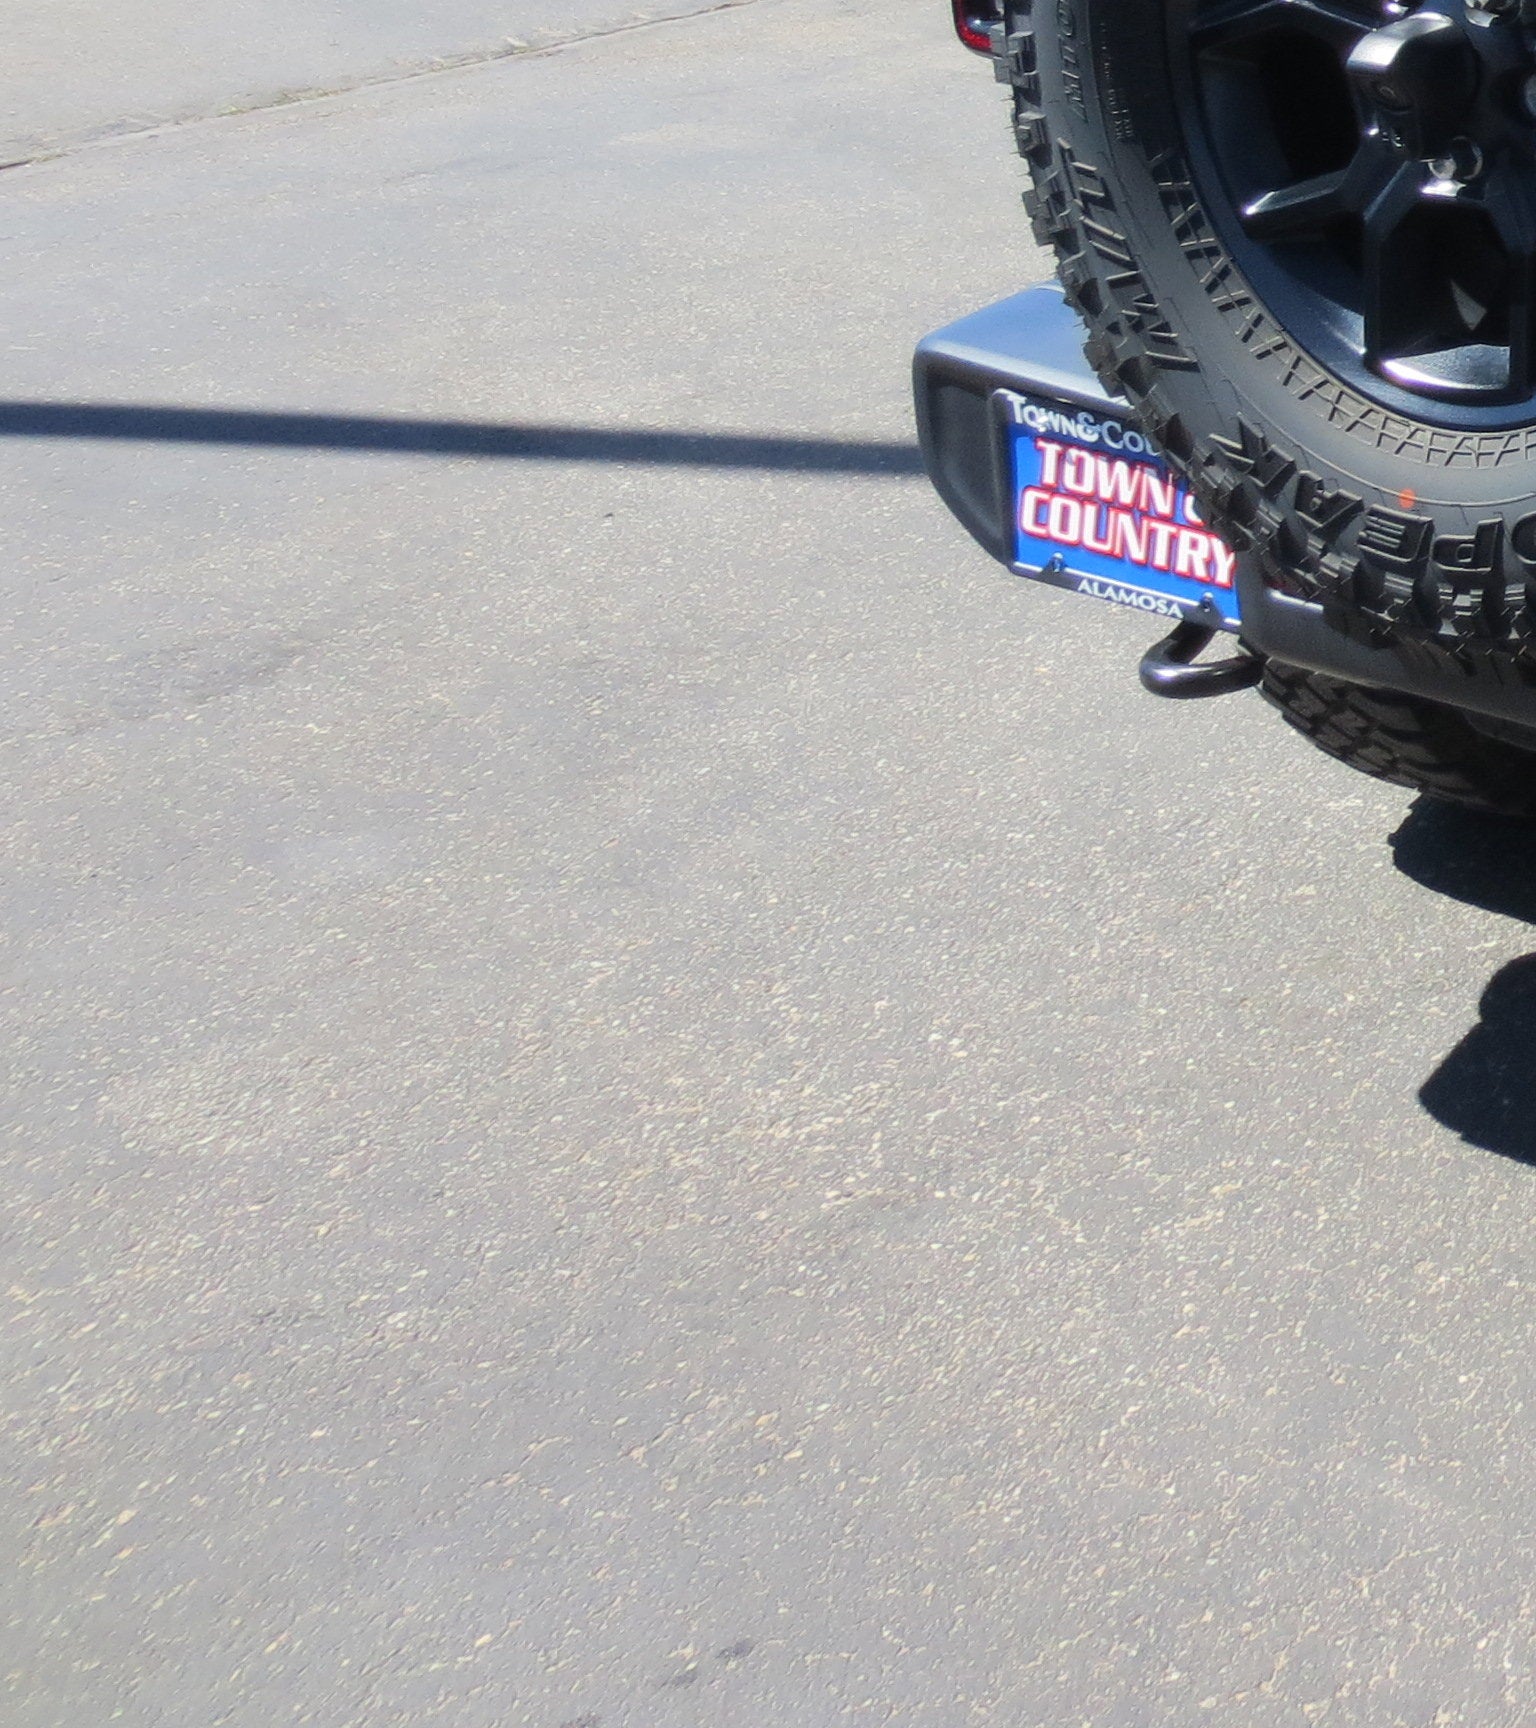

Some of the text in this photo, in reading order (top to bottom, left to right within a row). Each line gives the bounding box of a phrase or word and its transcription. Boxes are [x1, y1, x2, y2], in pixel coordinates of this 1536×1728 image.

[1035, 437, 1177, 519] TOWN
[1020, 485, 1238, 589] COUNTRY
[1076, 578, 1185, 619] ALAMOSA
